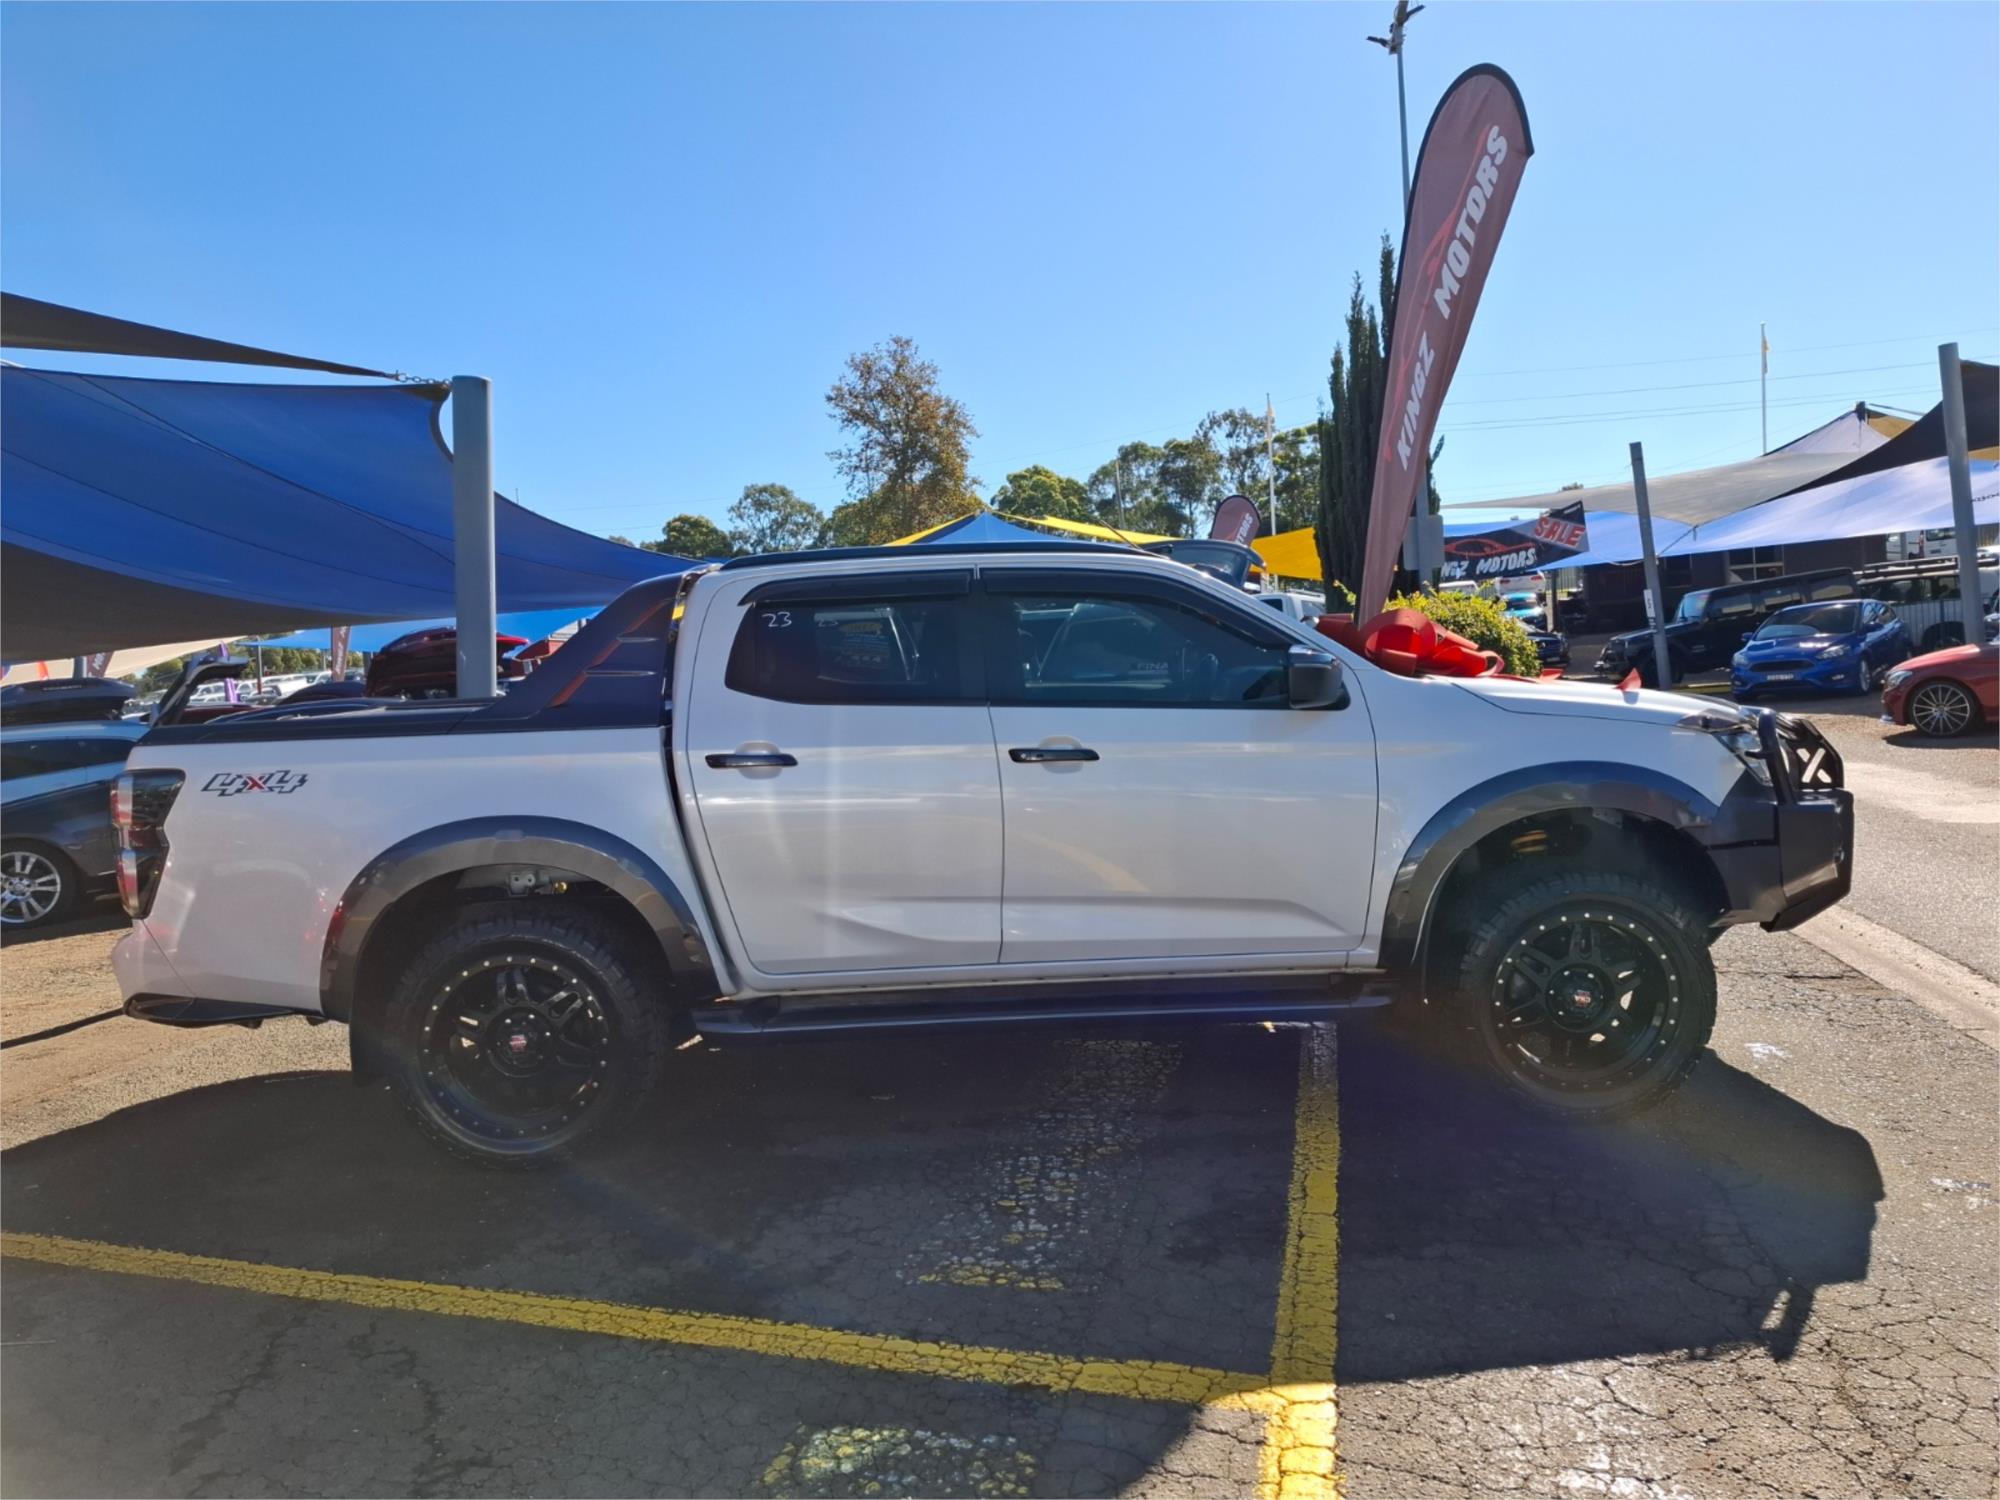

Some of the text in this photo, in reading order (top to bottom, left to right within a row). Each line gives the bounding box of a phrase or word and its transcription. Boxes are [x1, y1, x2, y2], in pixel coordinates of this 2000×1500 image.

[1398, 126, 1507, 470] KINGZ MOTORS
[1535, 516, 1584, 547] SALE
[1476, 548, 1536, 574] MOTORS
[762, 612, 792, 627] 23
